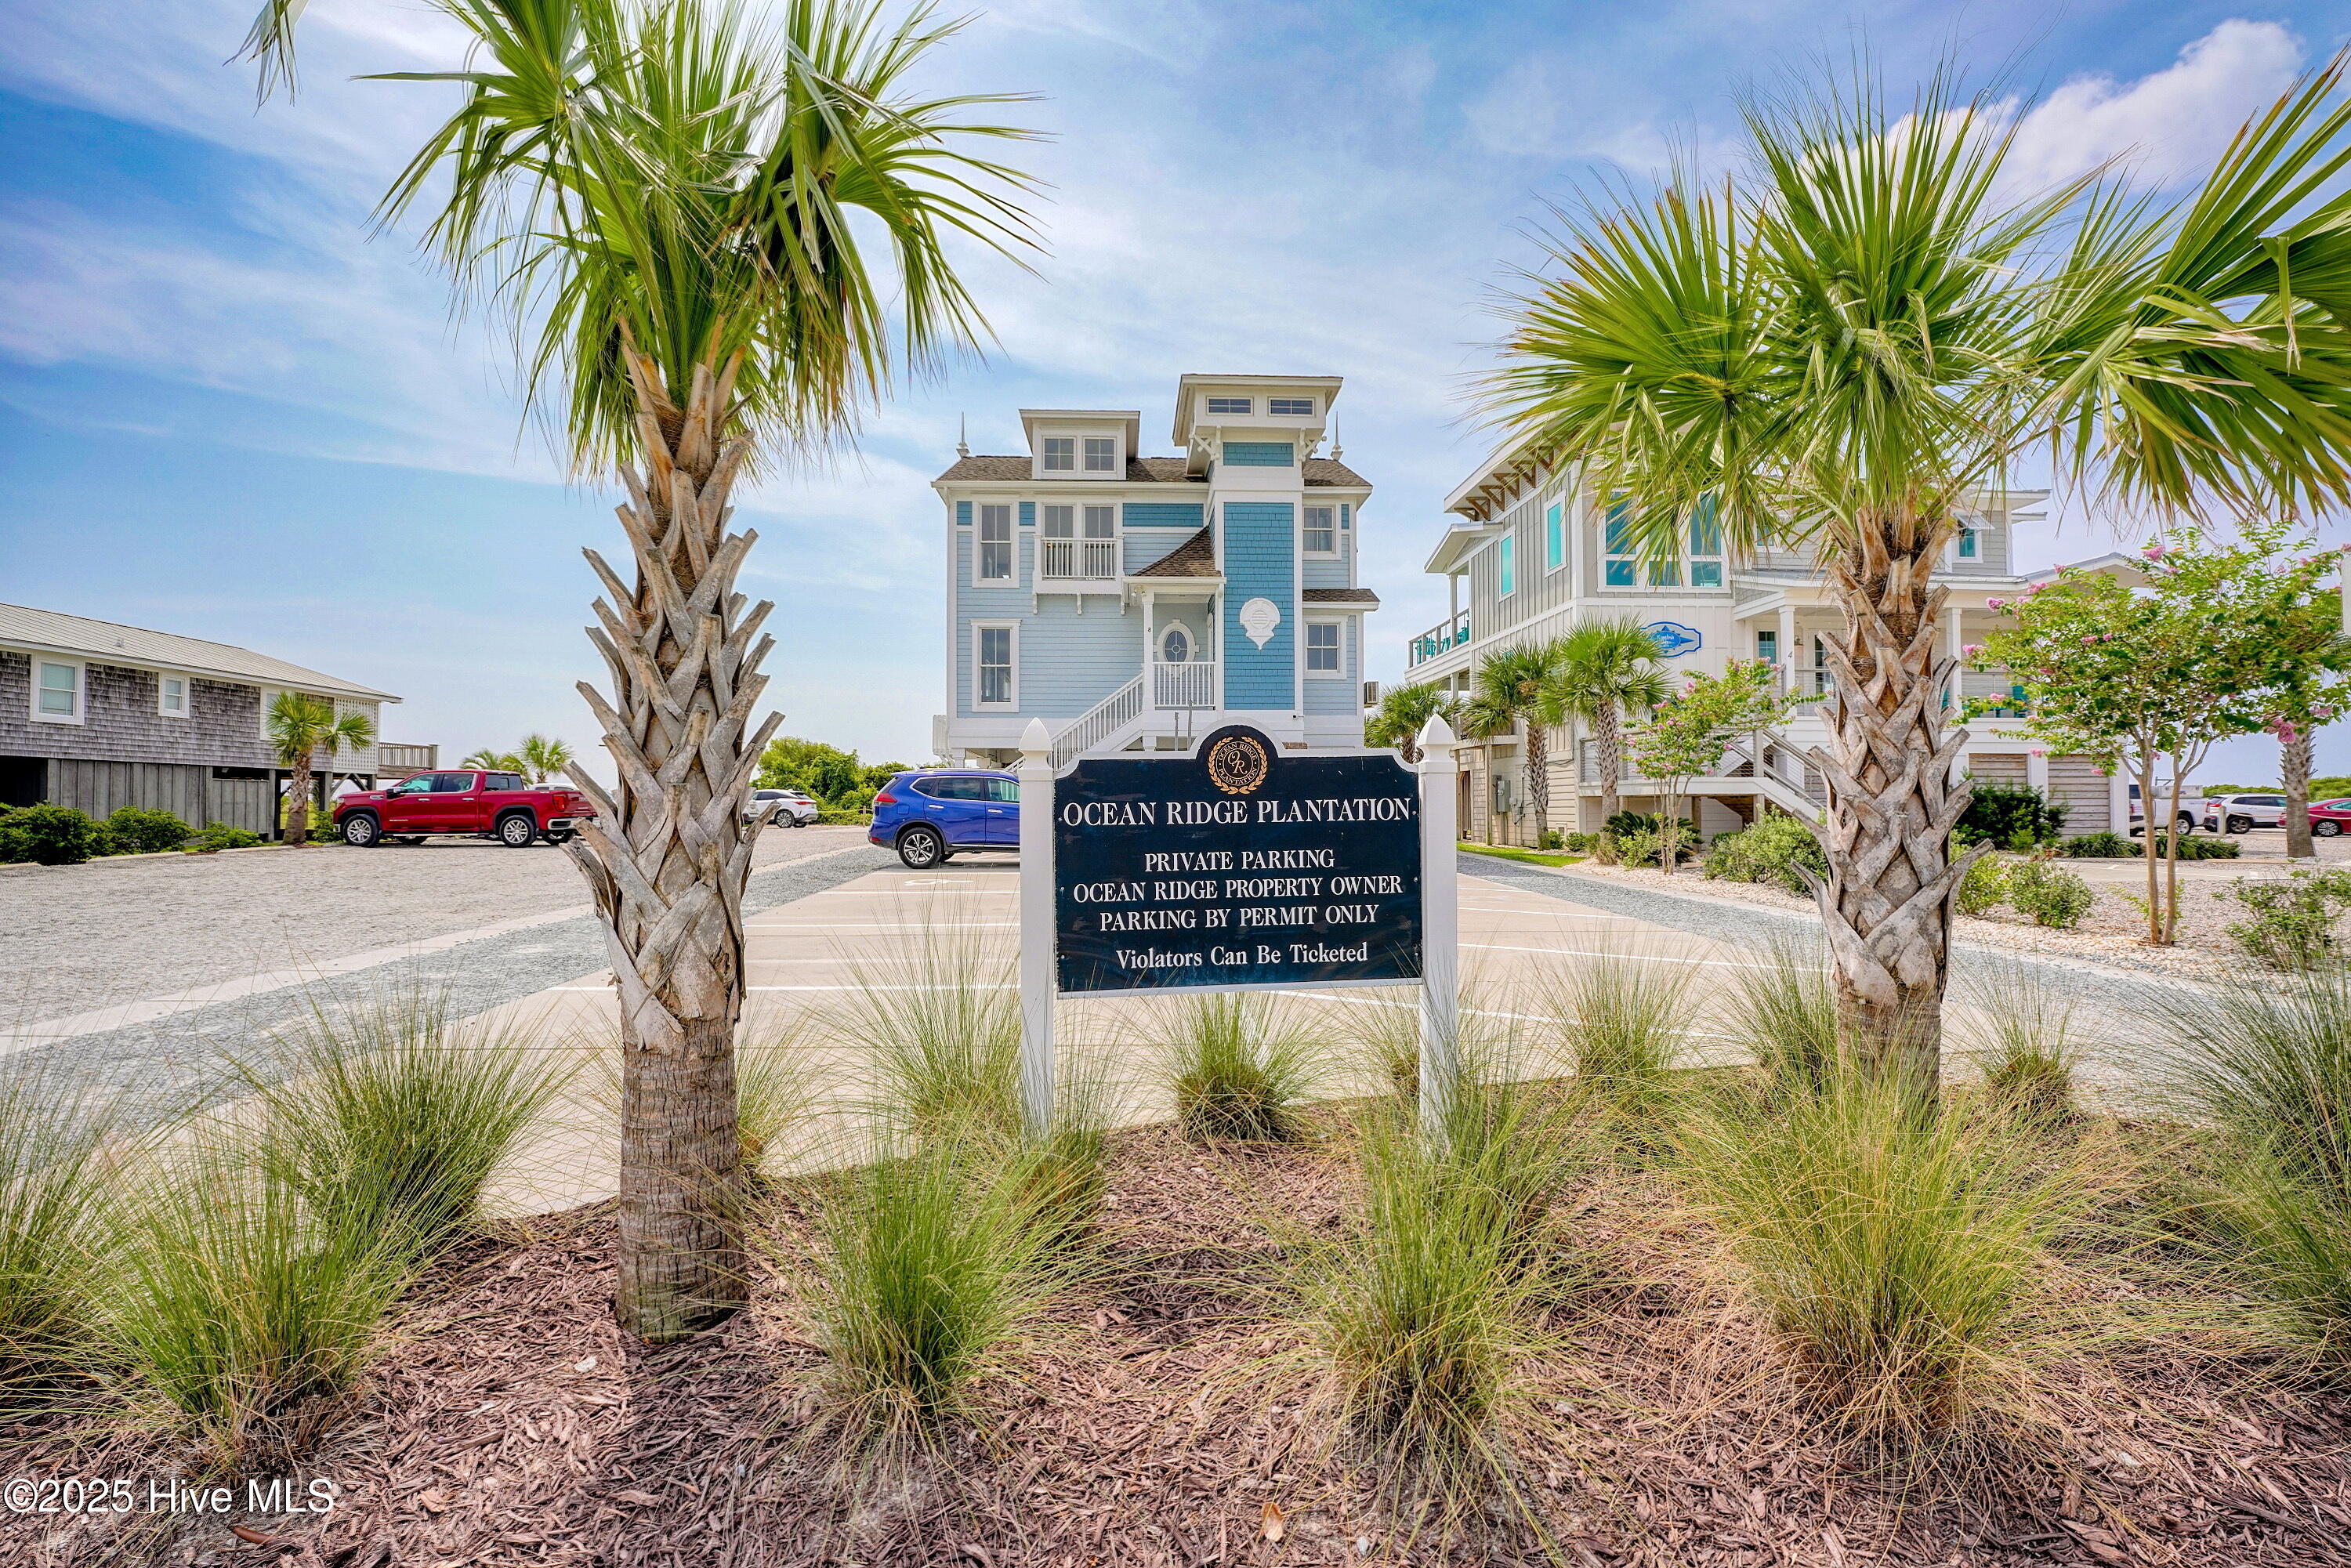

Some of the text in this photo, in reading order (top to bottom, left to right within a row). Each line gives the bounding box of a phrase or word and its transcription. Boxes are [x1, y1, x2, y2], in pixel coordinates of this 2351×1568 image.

[1219, 744, 1257, 760] OCEAN RIDGE
[1219, 767, 1257, 784] PLANTATION
[1063, 798, 1411, 826] OCEAN RIDGE PLANTATION
[1144, 849, 1335, 872] PRIVATE PARKING
[1073, 875, 1404, 903] OCEAN RIDGE PROPERTY OWNER
[1099, 904, 1379, 932] PARKING BY PERMIT ONLY
[1116, 941, 1368, 969] Violators Can Be Ticketed
